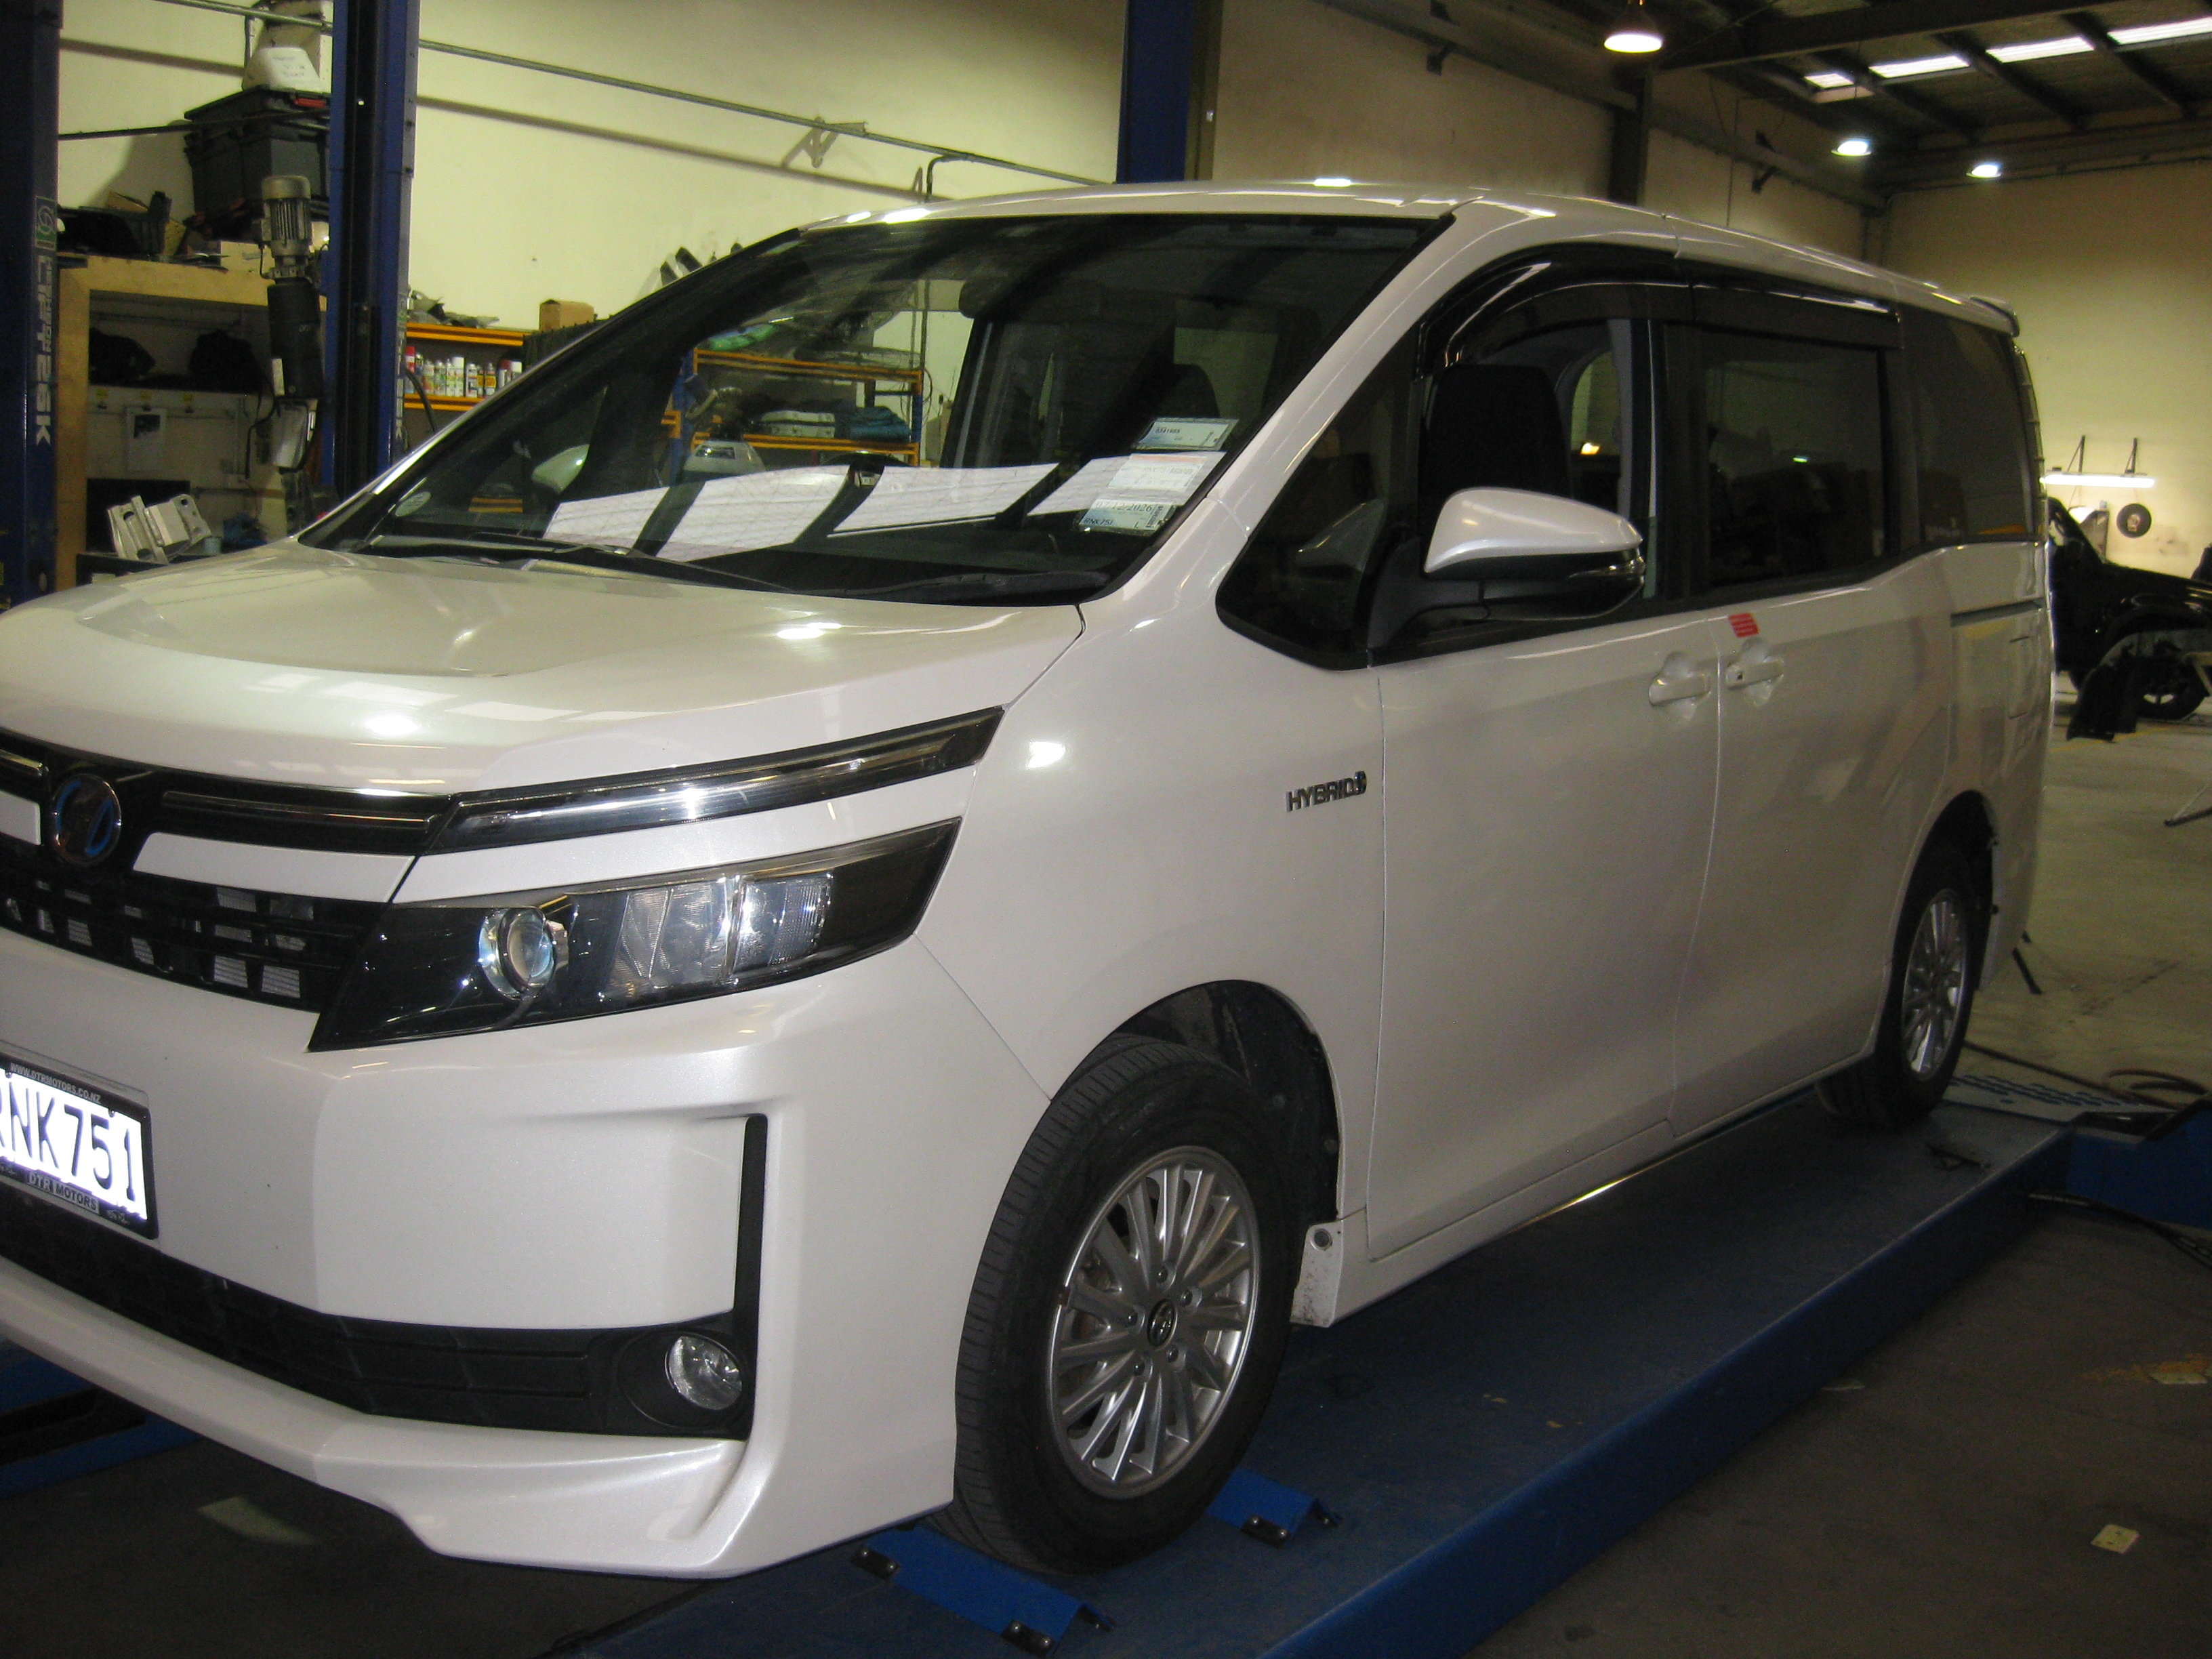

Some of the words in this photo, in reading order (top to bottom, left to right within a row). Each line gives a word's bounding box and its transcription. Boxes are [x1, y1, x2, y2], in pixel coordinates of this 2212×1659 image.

[1084, 517, 1113, 526] RNK751
[1285, 777, 1355, 813] HYBRID
[0, 1081, 136, 1202] NK751
[28, 1173, 54, 1192] DTR
[56, 1182, 98, 1212] MOTORS
